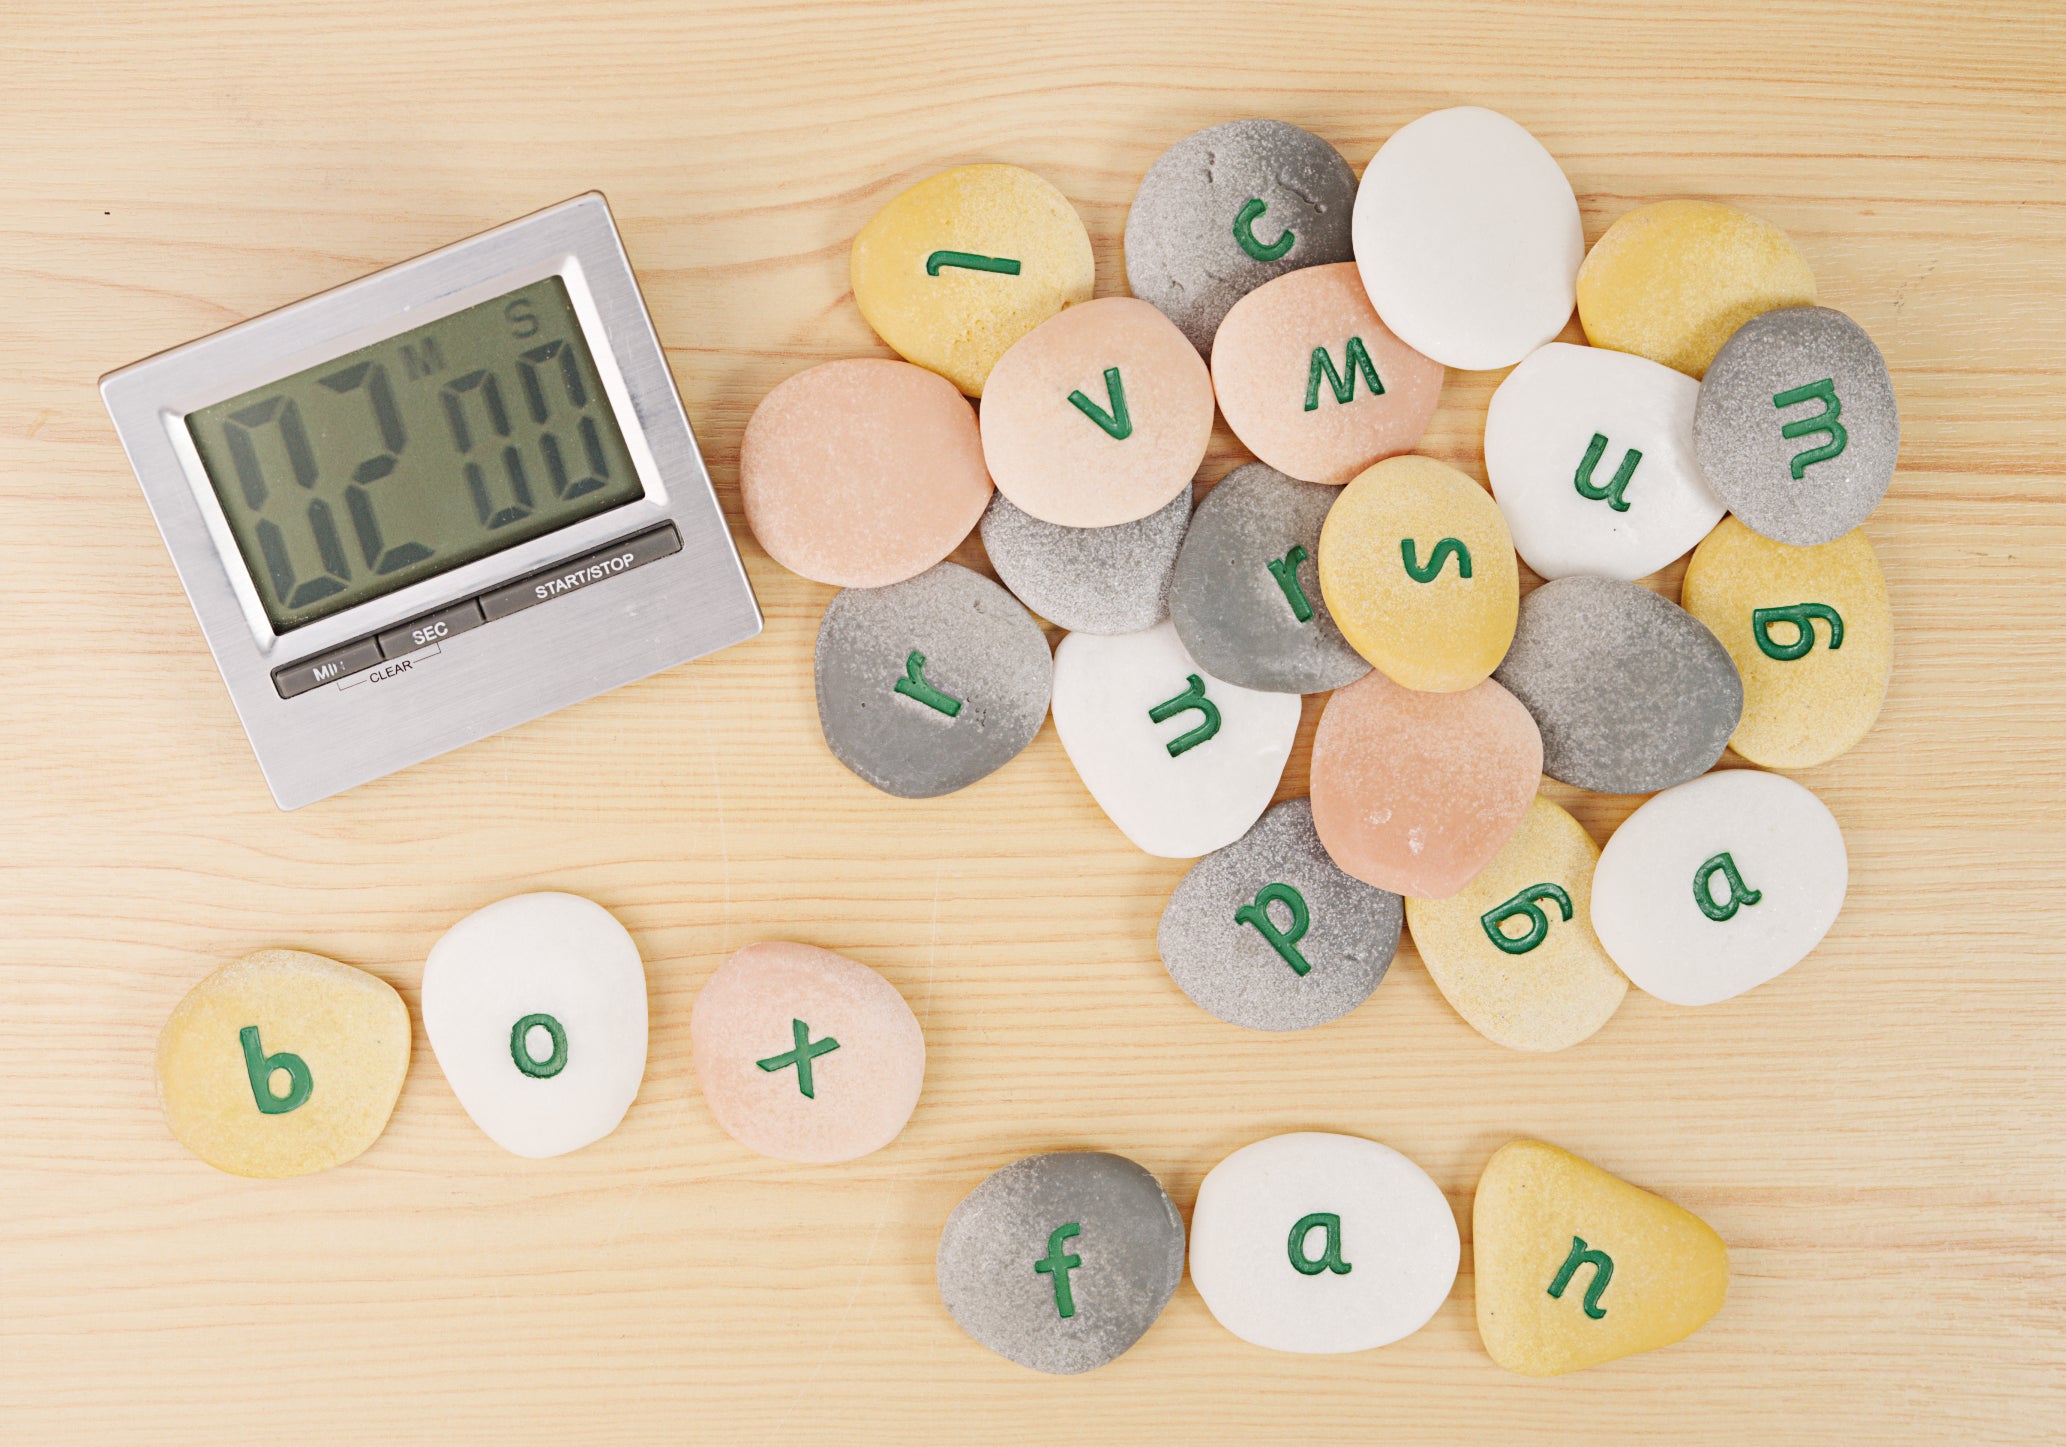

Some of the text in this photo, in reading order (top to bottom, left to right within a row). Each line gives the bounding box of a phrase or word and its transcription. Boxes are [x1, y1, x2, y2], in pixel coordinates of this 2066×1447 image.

[1232, 198, 1295, 263] c
[504, 299, 540, 339] S
[402, 336, 445, 382] M
[1772, 378, 1848, 481] m
[1574, 433, 1643, 513] u
[534, 552, 635, 600] START/STOP
[1267, 546, 1317, 624] r
[1401, 537, 1473, 584] s
[411, 621, 449, 645] SEC
[369, 659, 414, 684] CLEAR
[893, 650, 962, 718] r
[1692, 851, 1762, 923] a
